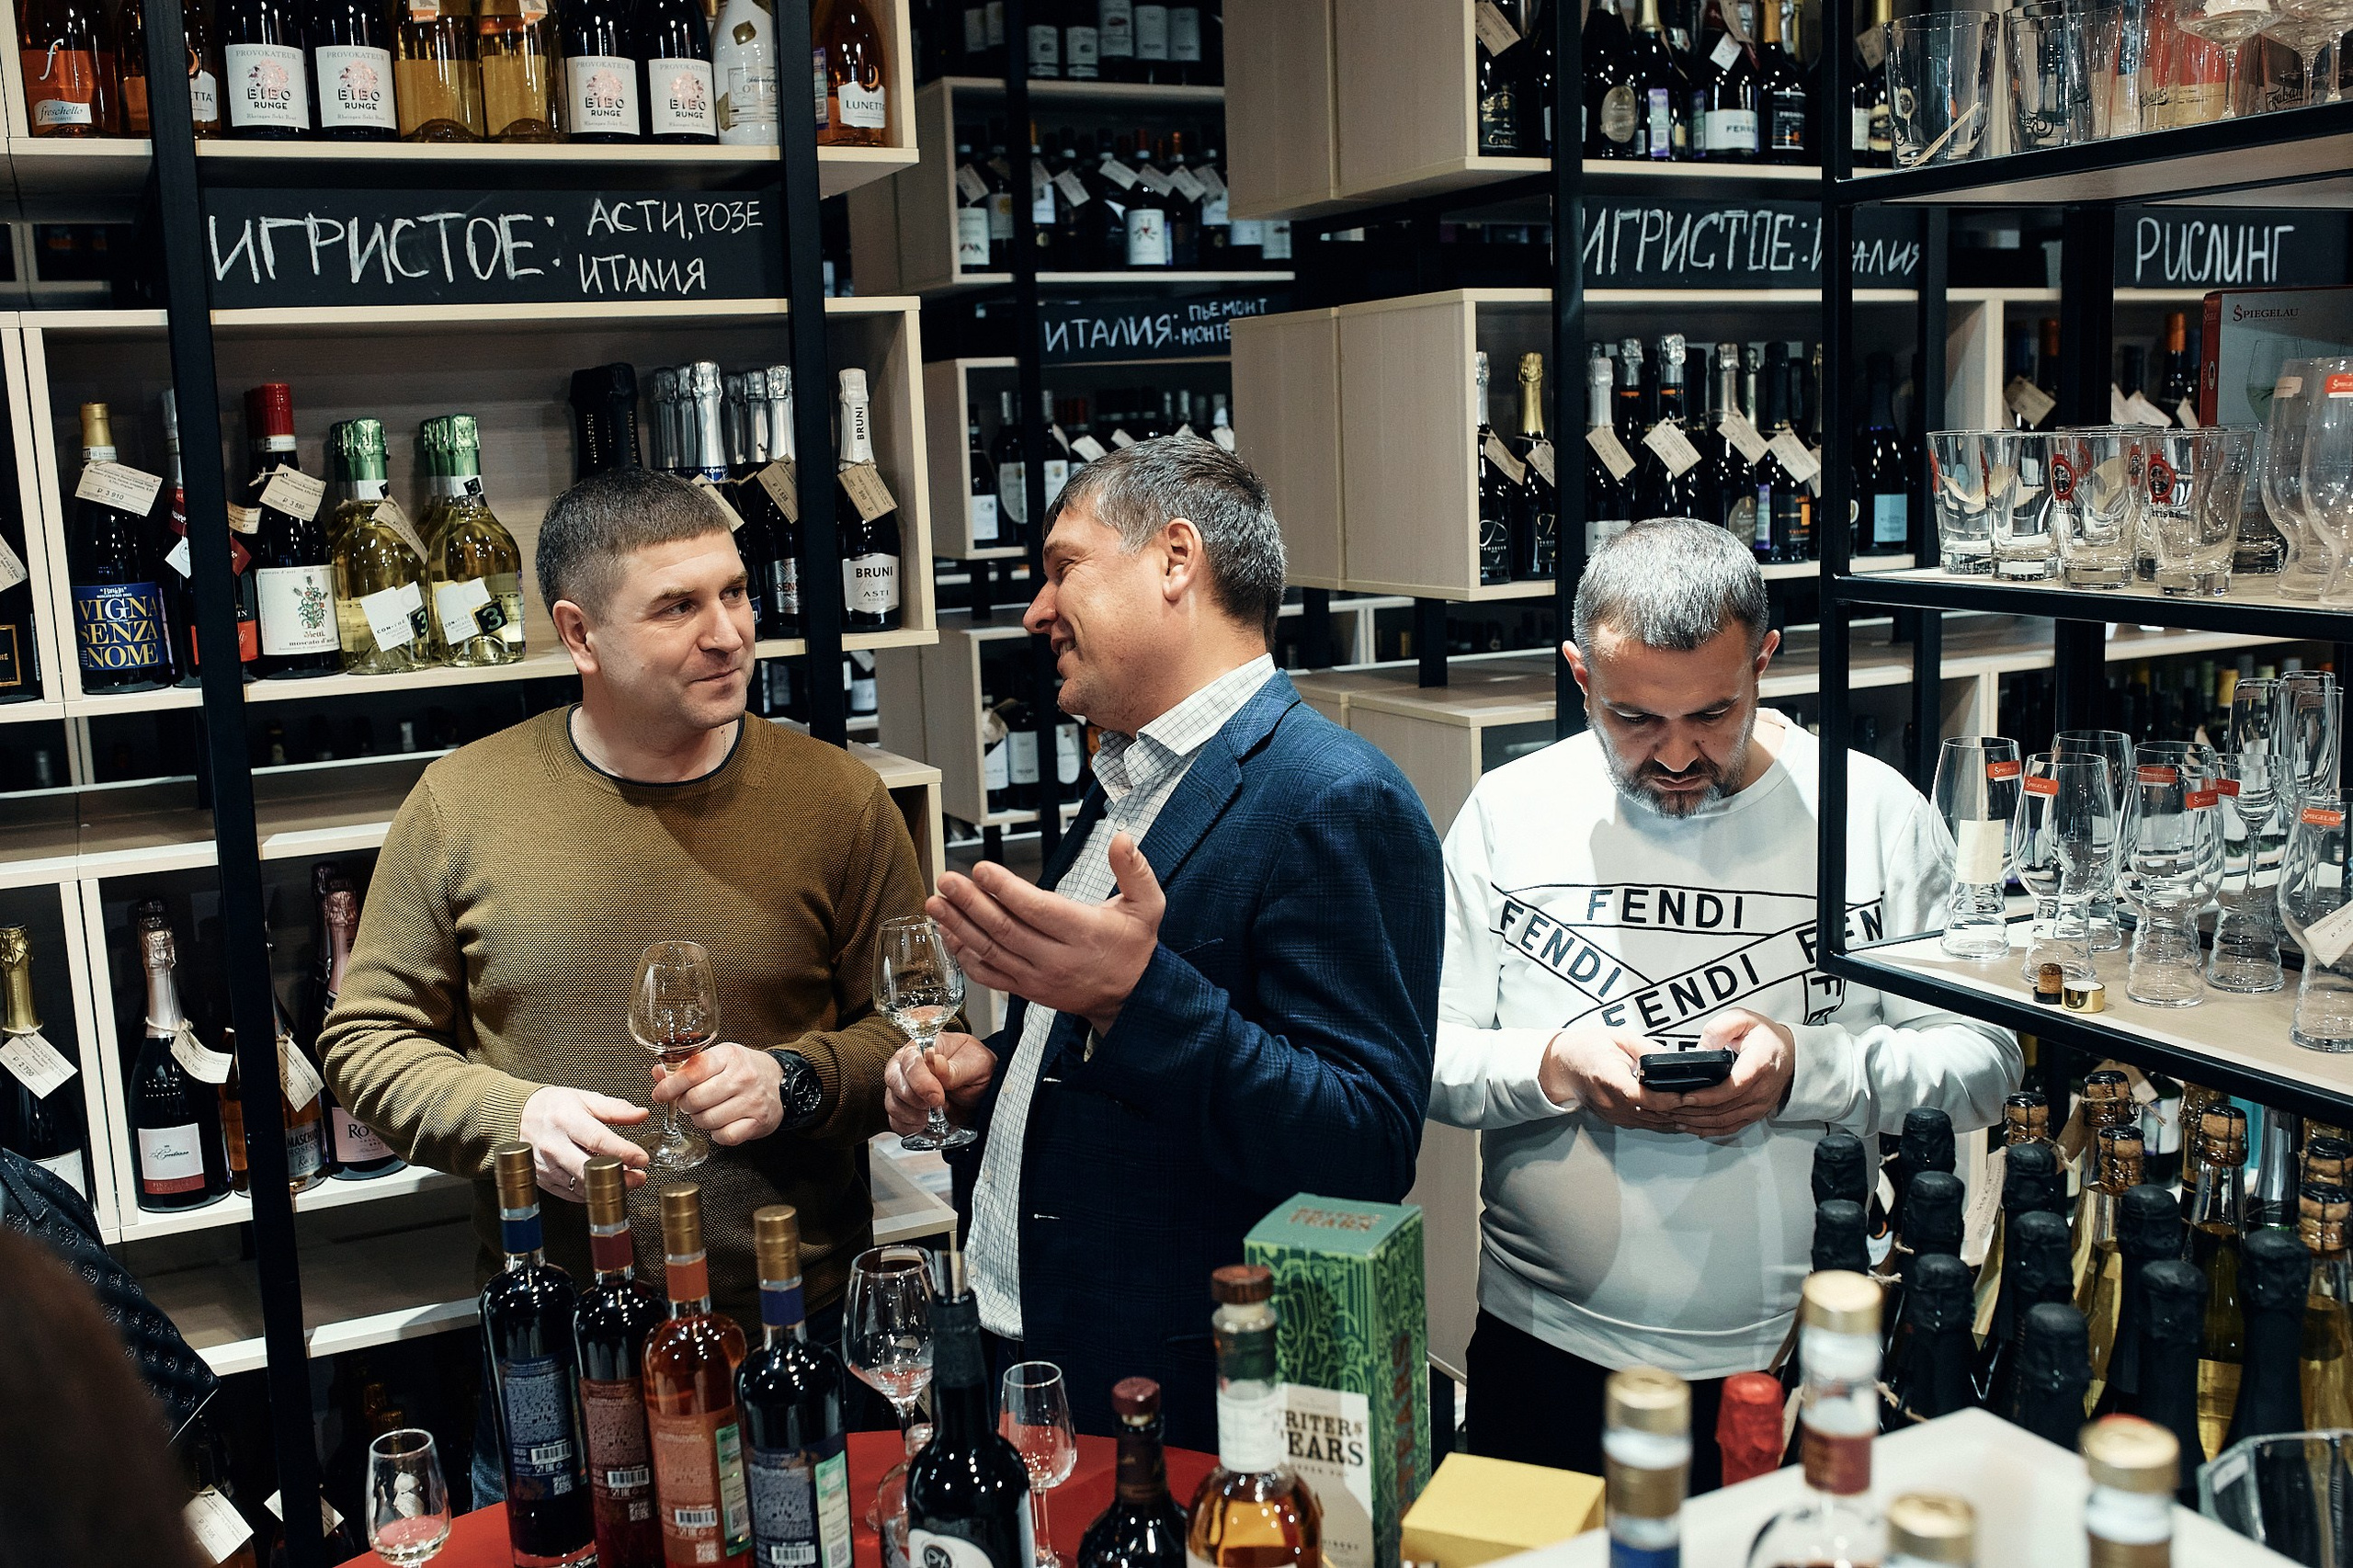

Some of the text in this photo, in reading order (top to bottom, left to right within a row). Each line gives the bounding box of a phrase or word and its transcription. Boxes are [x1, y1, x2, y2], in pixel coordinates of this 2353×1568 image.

[235, 50, 297, 61] PROVOKATEUR
[247, 87, 291, 101] BIBO
[337, 88, 381, 102] BIBO
[585, 97, 624, 108] BIBO
[670, 97, 706, 111] BIBO
[254, 101, 288, 110] RUNGE
[345, 102, 377, 110] RUNGE
[591, 109, 621, 118] RUNGE
[676, 110, 704, 119] RUNGE
[209, 211, 562, 285] ИГРИСТОЕ:
[2135, 216, 2296, 284] РИСЛИНГ
[579, 253, 707, 296] ИТАЛИЯ
[2234, 304, 2299, 322] SPIEGELAU
[855, 406, 865, 440] BRUNI
[856, 565, 893, 578] BRUNI
[863, 589, 889, 597] ASTI
[78, 596, 159, 621] VIGNA
[482, 607, 503, 630] 3
[416, 610, 428, 634] 3
[79, 620, 158, 645] SENZA
[86, 642, 159, 668] NOME
[2302, 810, 2339, 823] SPIEGELAU
[1586, 889, 1744, 929] FENDI
[1499, 899, 1622, 998] FENDI
[287, 1129, 318, 1149] MASCHIO
[1284, 1410, 1364, 1438] RITERS
[1281, 1429, 1364, 1467] EARS
